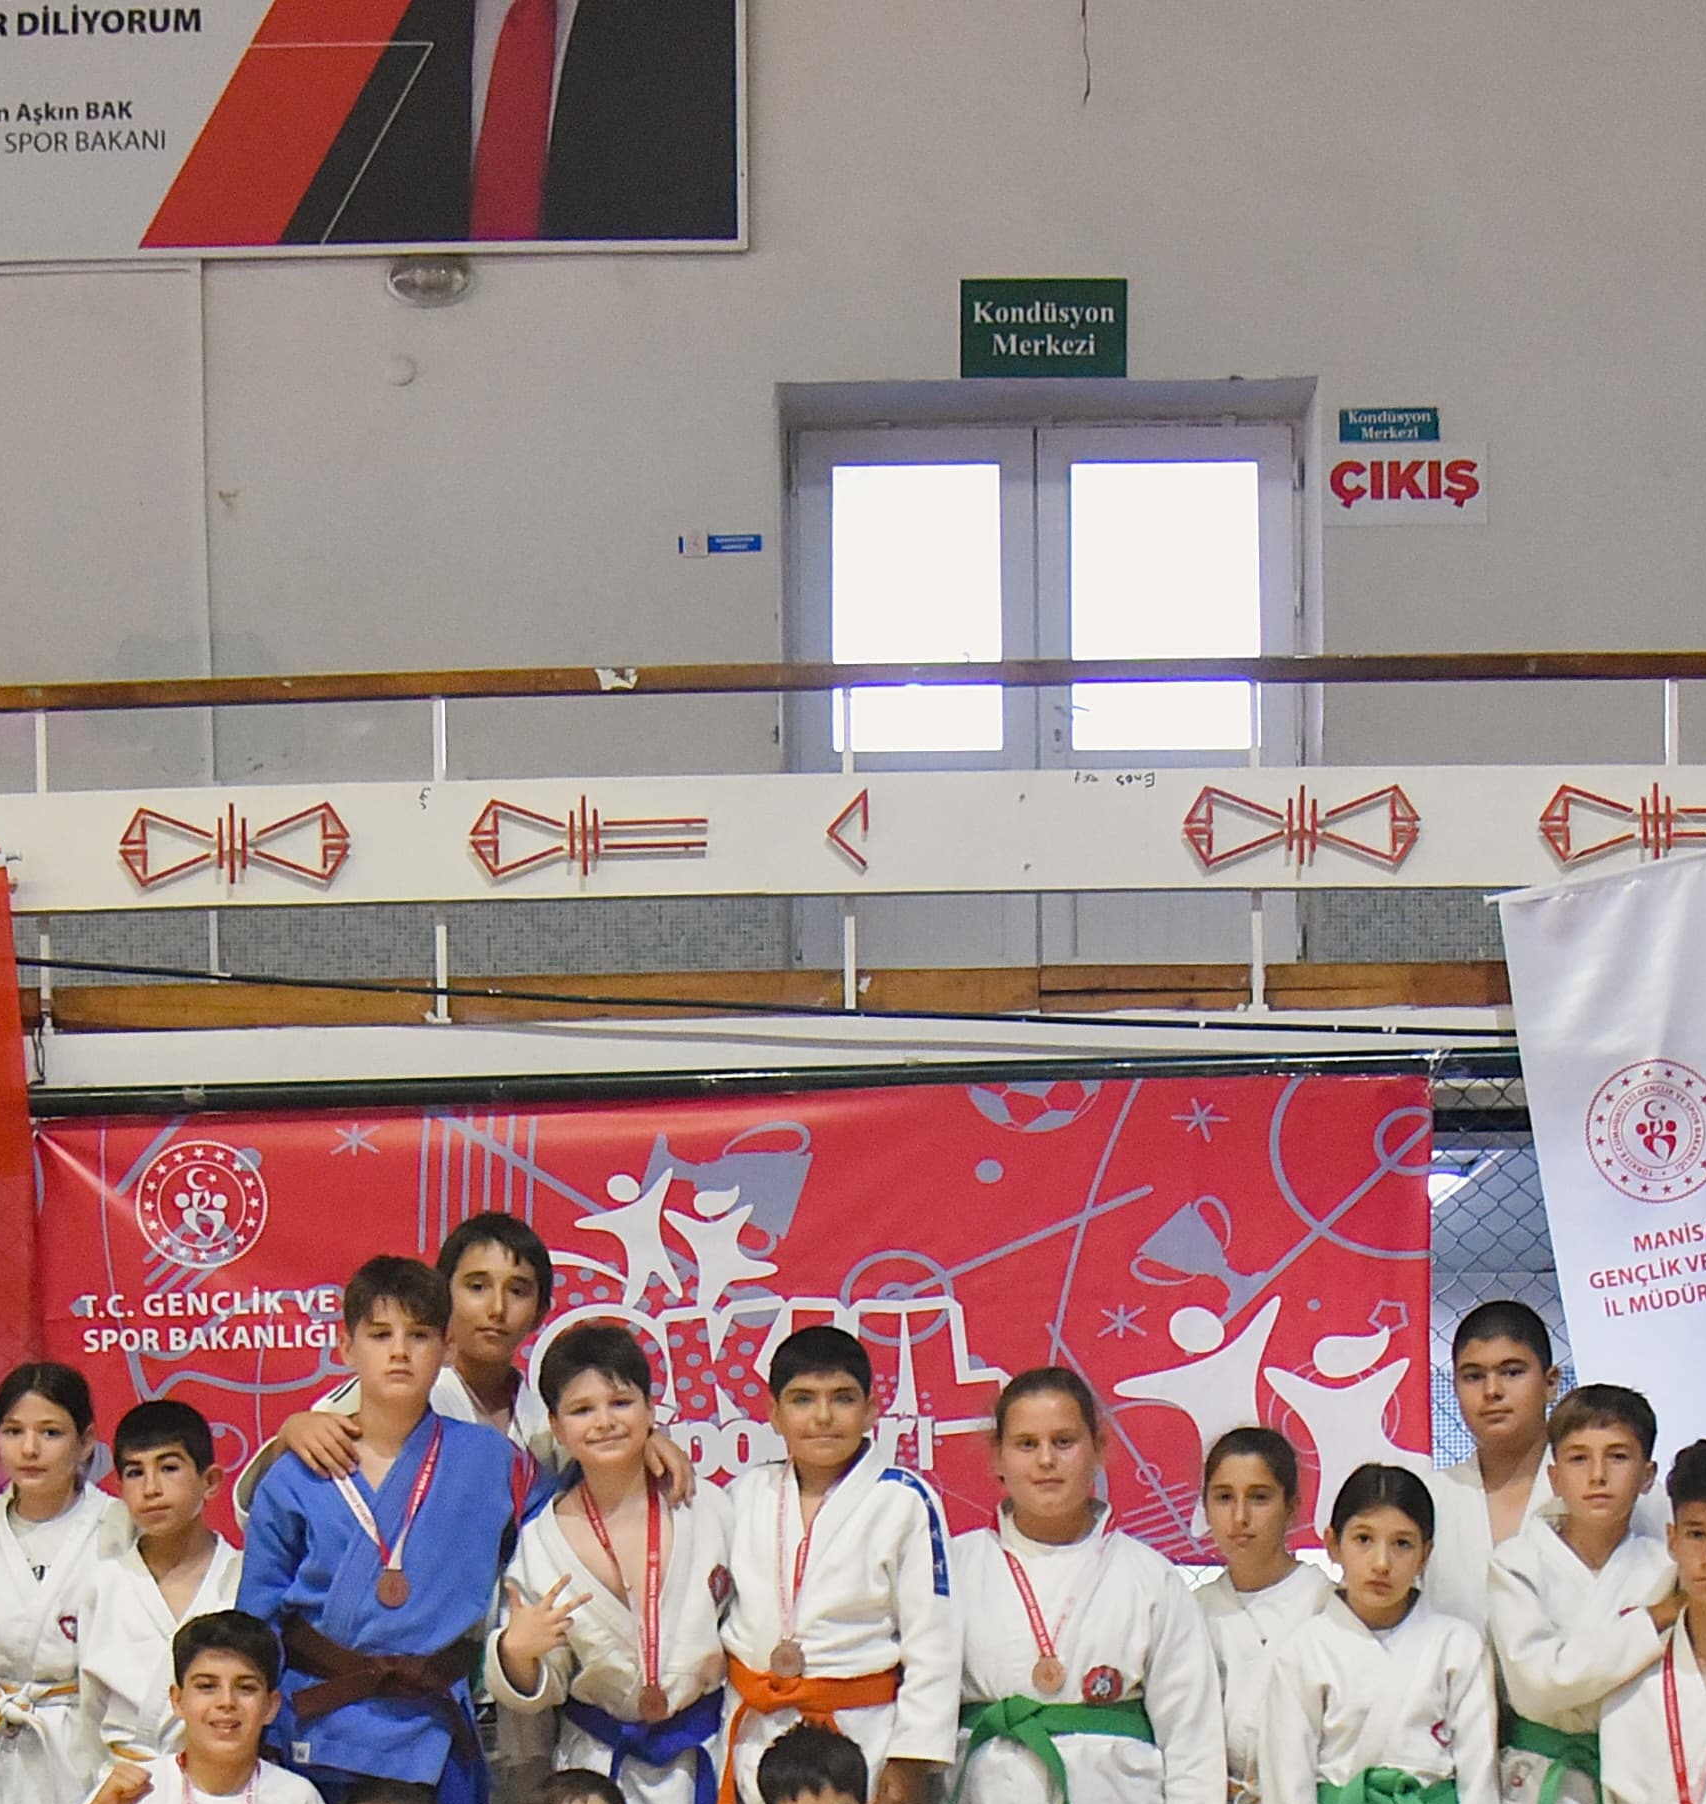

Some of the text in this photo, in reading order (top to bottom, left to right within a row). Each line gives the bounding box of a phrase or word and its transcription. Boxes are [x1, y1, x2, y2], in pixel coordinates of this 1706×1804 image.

[17, 4, 202, 37] DİLİYORUM
[17, 103, 79, 126] Aşkın
[86, 101, 133, 121] BAK
[5, 132, 68, 154] SPOR
[75, 129, 166, 152] BAKANI
[973, 300, 1115, 330] Kondüsyon
[993, 333, 1096, 356] Merkezi
[1348, 411, 1432, 426] Kondüsyon
[1361, 426, 1419, 440] Merkezi
[1330, 459, 1480, 509] ÇIKIŞ
[1589, 1258, 1682, 1289] GENÇLİK
[82, 1286, 335, 1321] T.C. GENÇLİK VE
[1604, 1296, 1624, 1318] İL
[83, 1319, 337, 1353] SPOR BAKANLIĞI
